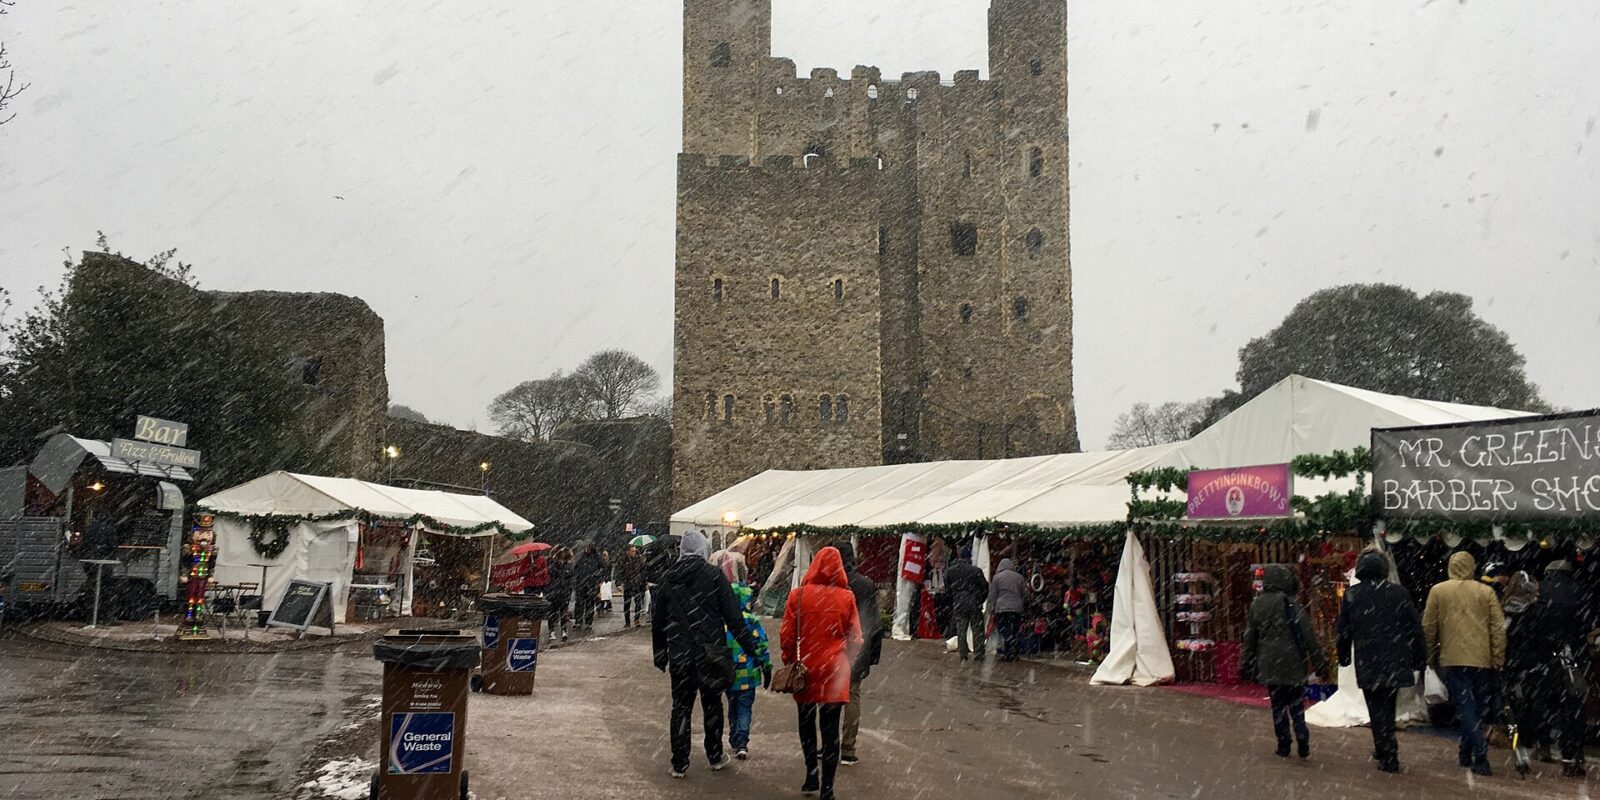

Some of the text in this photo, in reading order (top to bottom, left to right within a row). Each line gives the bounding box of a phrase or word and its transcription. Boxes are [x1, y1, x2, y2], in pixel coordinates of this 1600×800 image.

[136, 417, 186, 444] Bar
[1398, 425, 1600, 468] MR GREEN
[1188, 473, 1287, 514] PRETTYINPINKBOWS
[1382, 479, 1518, 512] BARBER
[403, 742, 442, 751] Waste
[404, 732, 451, 741] General
